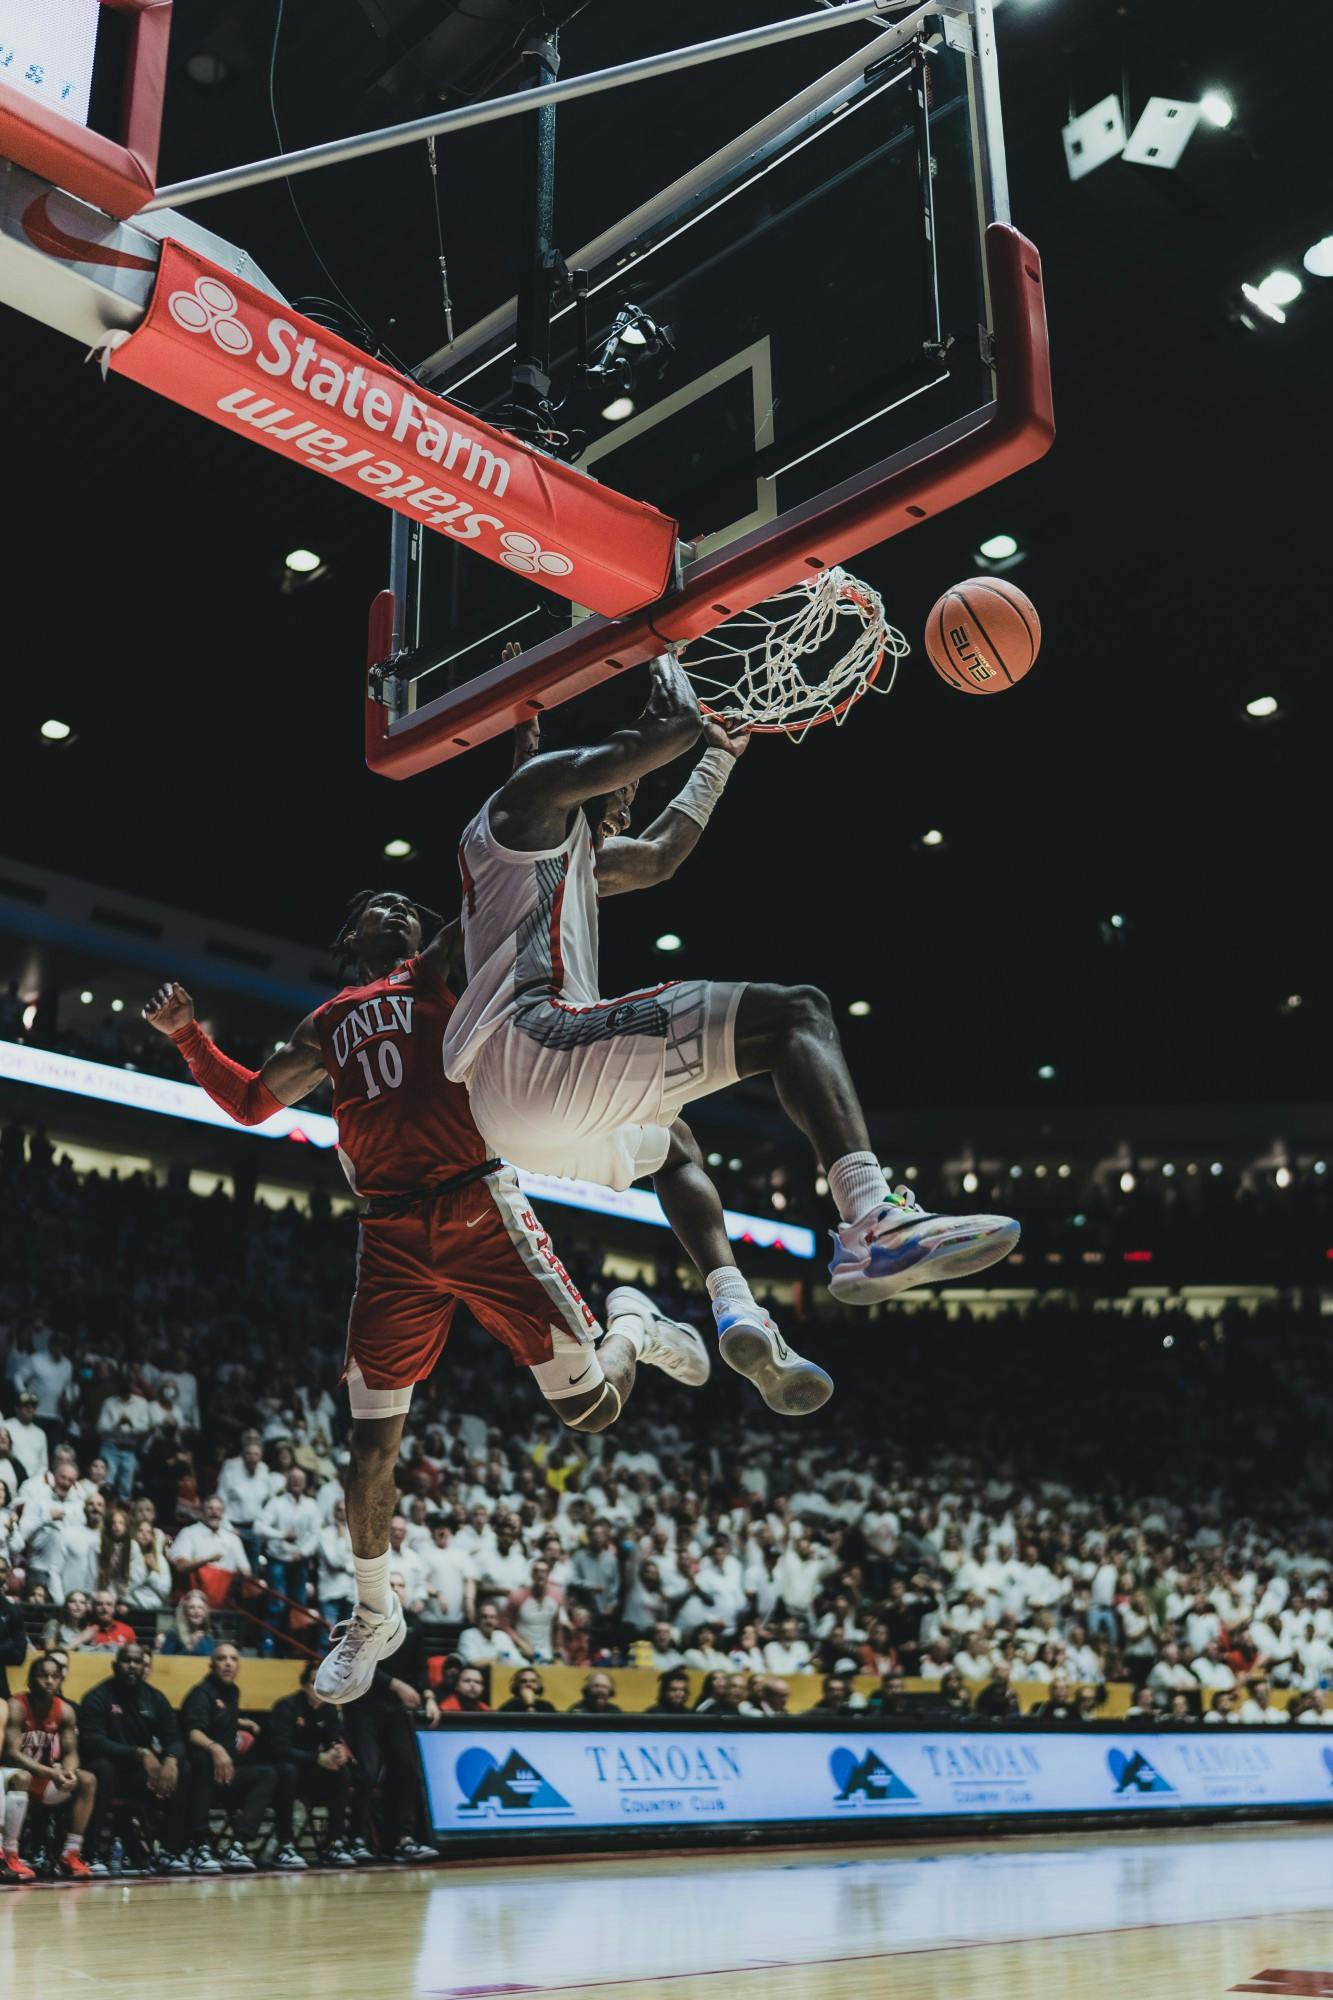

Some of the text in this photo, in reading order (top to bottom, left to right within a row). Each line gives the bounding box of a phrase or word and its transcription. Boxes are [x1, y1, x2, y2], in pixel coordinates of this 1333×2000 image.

[949, 625, 991, 683] ELITE
[332, 995, 415, 1068] UNLV
[356, 1039, 403, 1100] 10
[585, 1745, 743, 1782] TANOAN
[921, 1745, 1042, 1777] TANOAN
